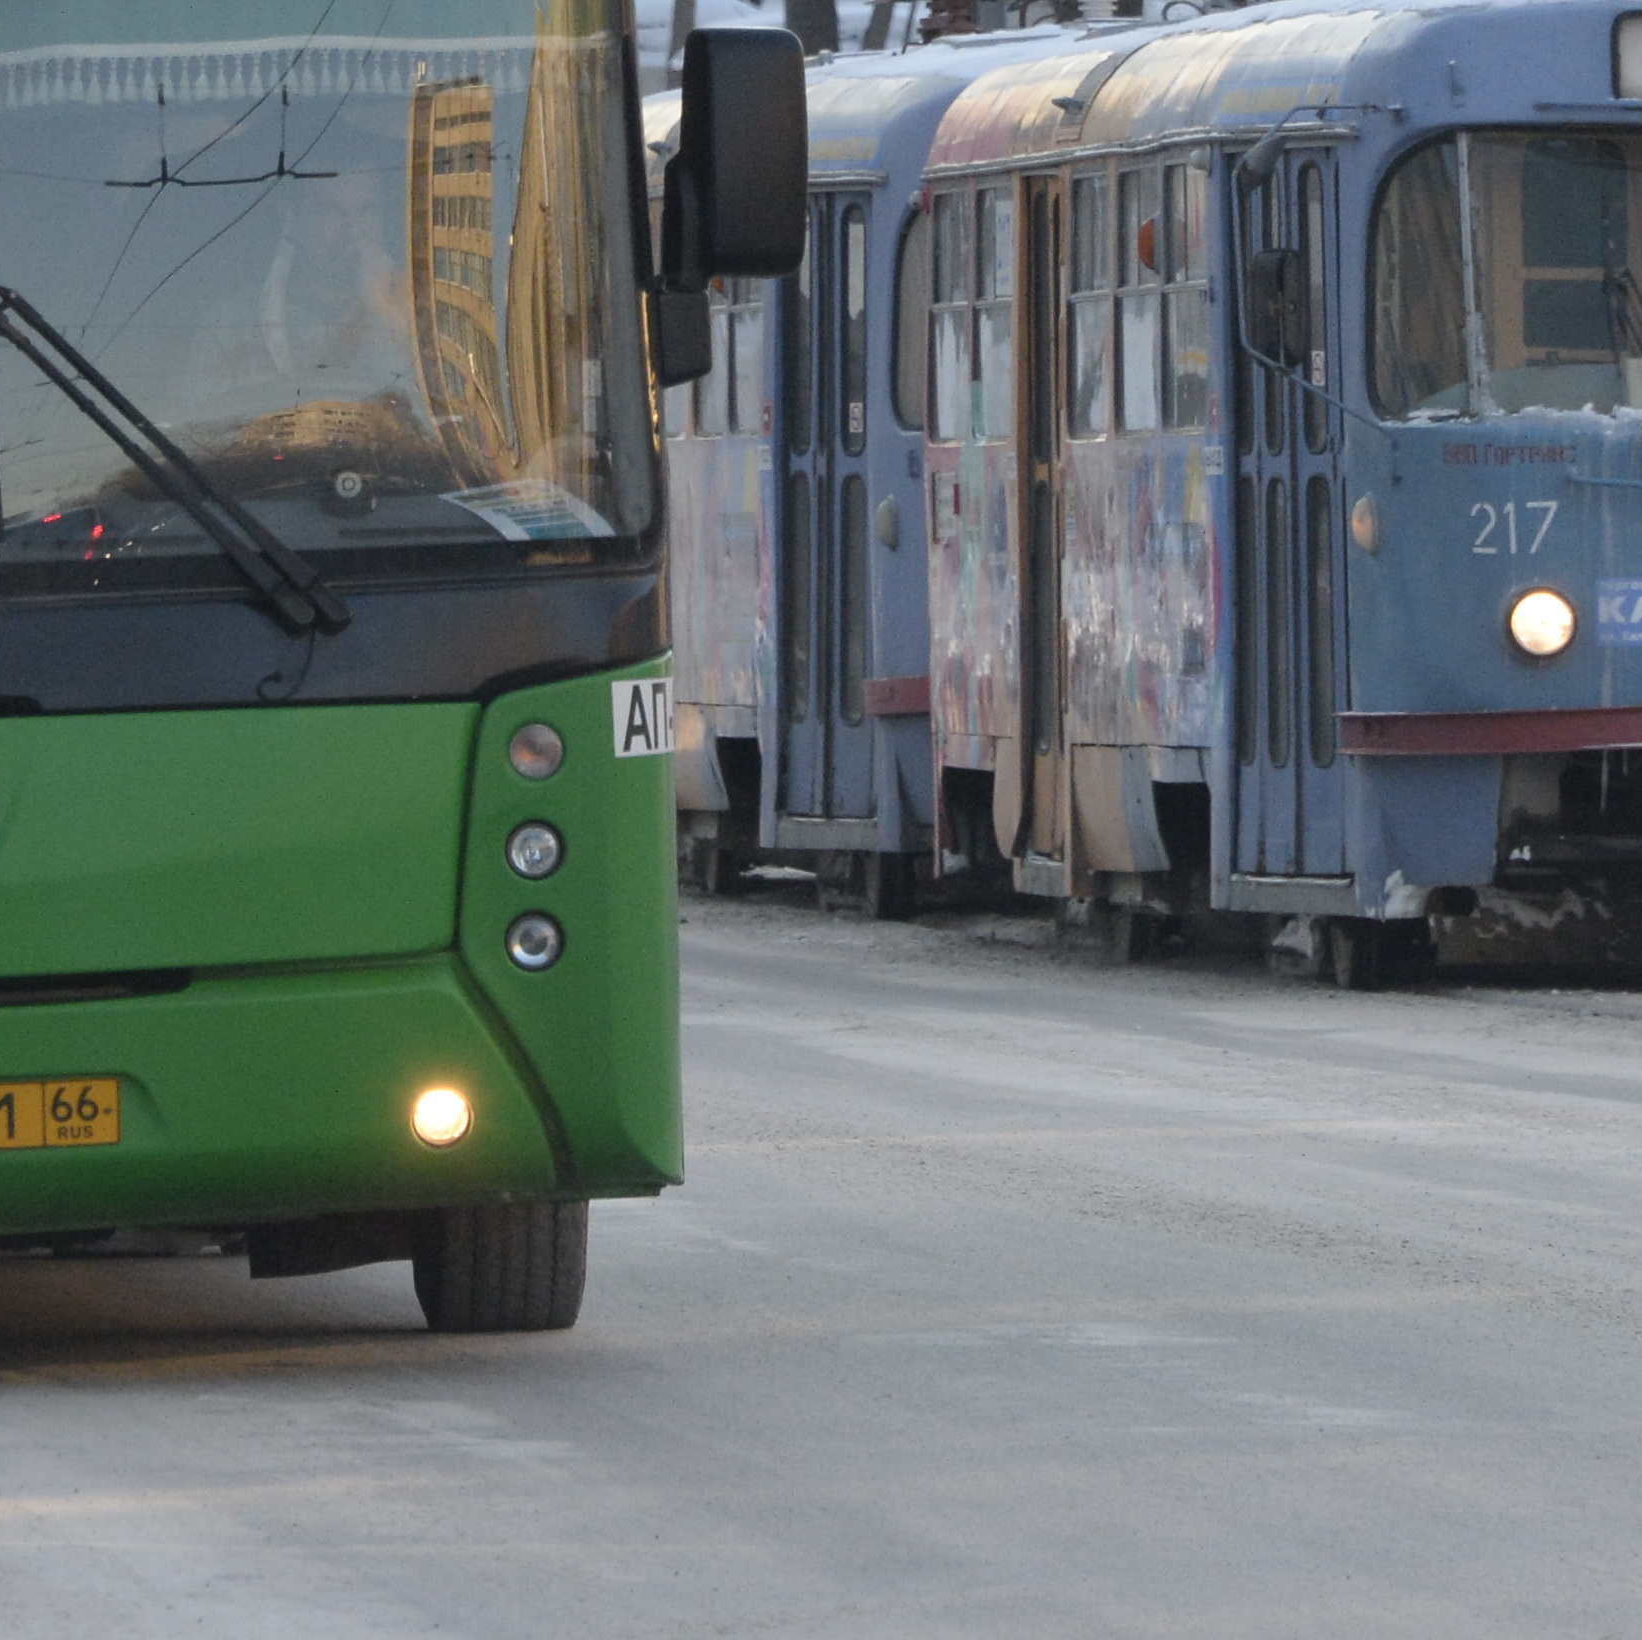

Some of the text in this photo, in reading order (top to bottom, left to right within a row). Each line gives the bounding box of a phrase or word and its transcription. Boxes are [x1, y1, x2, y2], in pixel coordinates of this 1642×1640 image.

[1469, 500, 1559, 555] 217
[51, 1085, 100, 1123] 66
[57, 1124, 94, 1140] RUS
